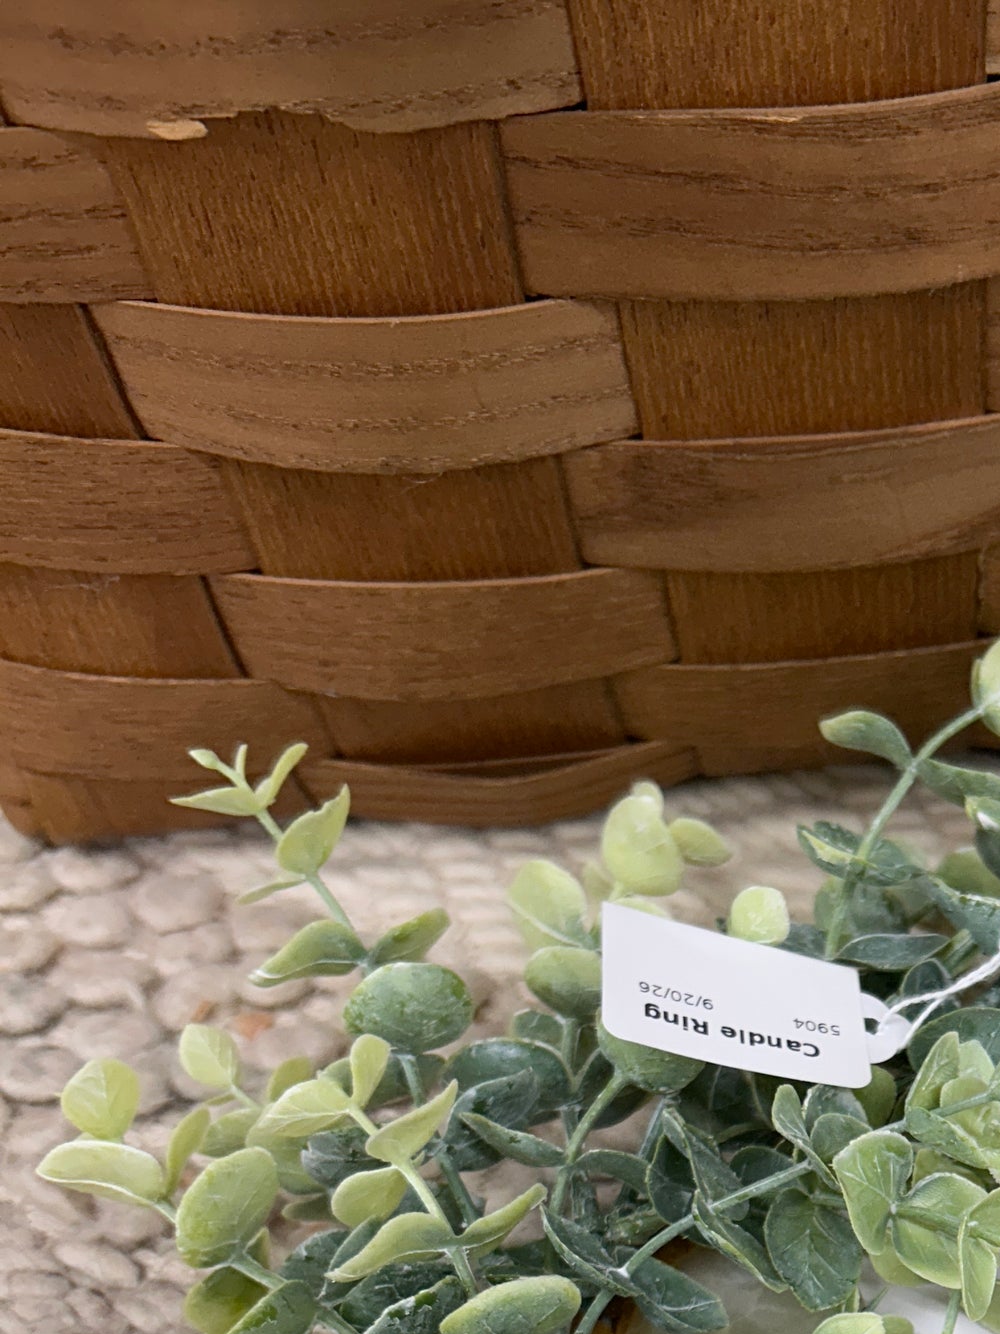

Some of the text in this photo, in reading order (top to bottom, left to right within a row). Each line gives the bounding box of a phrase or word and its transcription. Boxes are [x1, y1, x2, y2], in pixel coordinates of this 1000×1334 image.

[638, 981, 714, 1011] 9/20/26
[644, 1003, 820, 1058] Candle Ring
[793, 1018, 840, 1036] 5904
